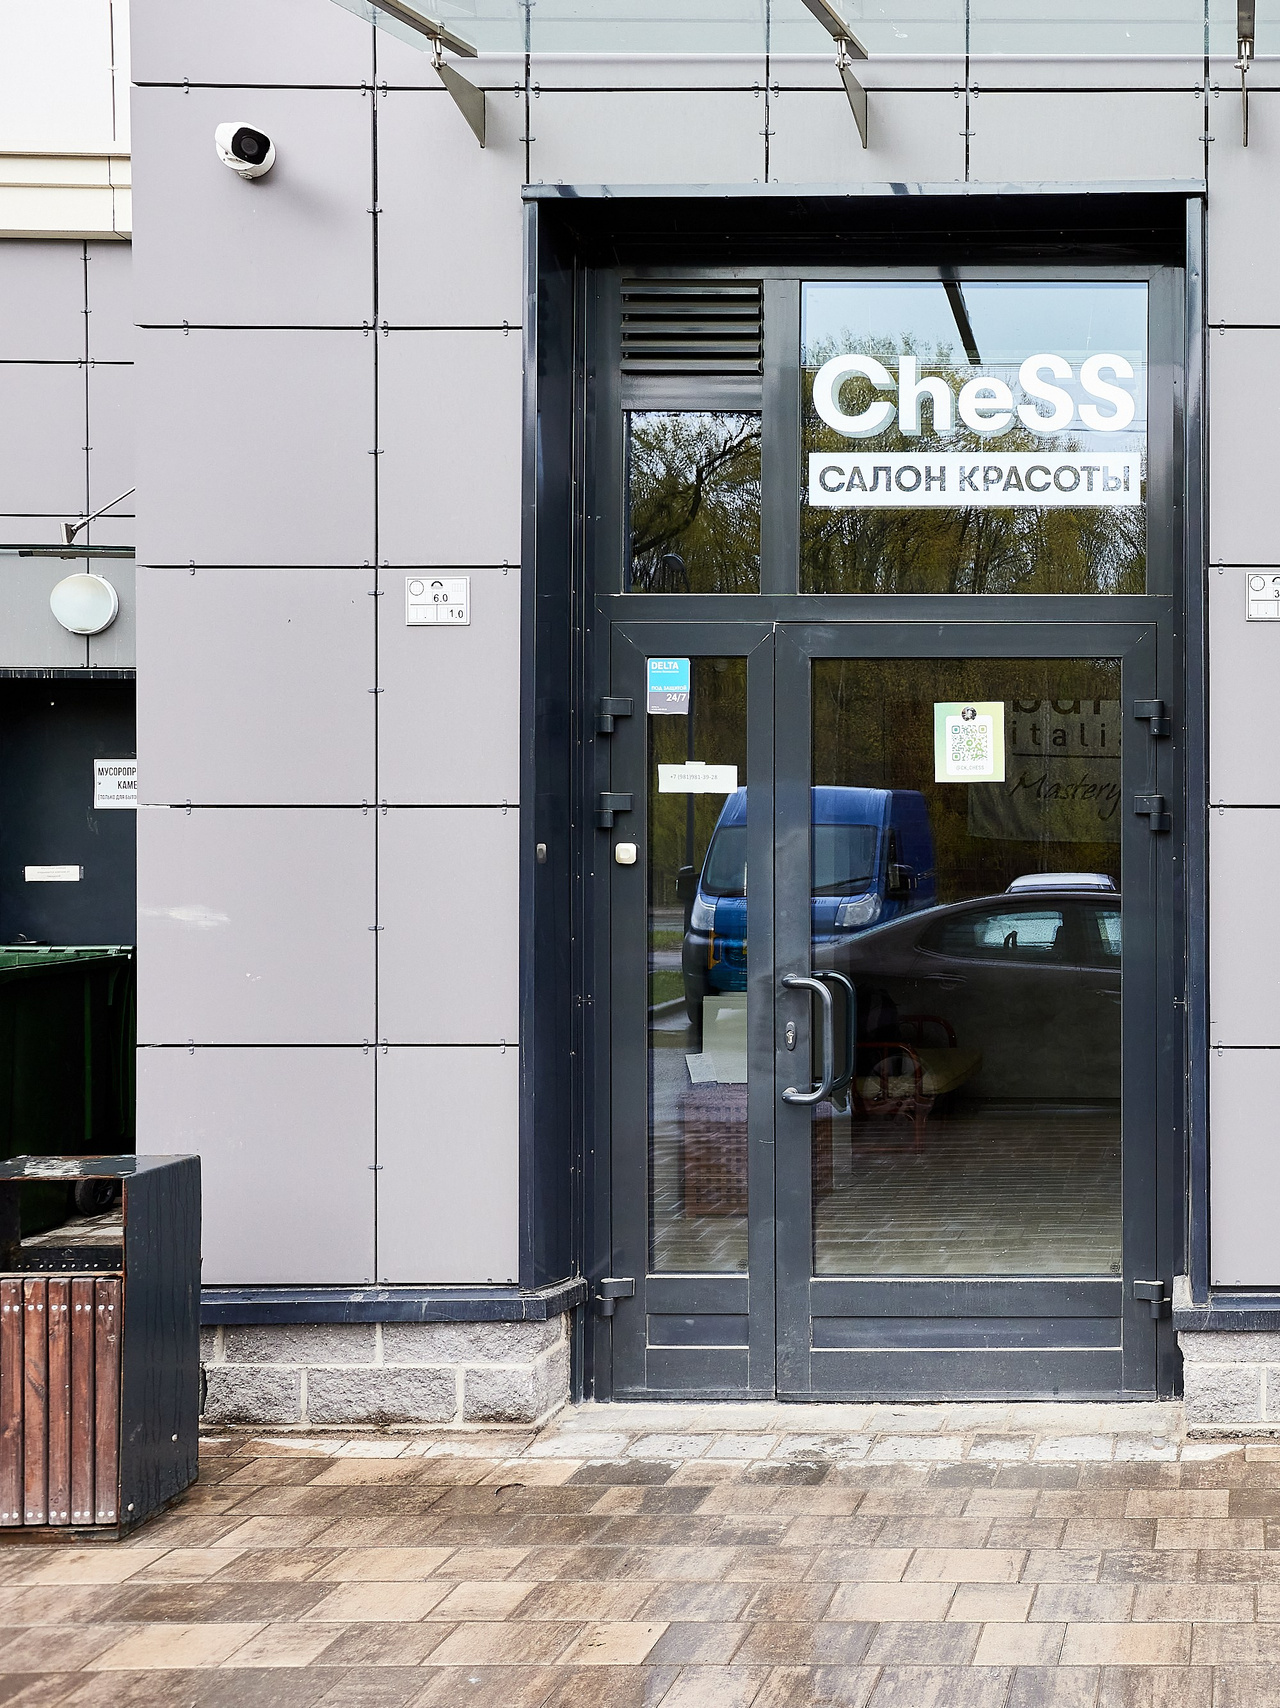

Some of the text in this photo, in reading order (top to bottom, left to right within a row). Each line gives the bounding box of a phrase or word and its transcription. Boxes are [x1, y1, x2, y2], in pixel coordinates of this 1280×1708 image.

[812, 353, 1136, 434] CheSS
[818, 465, 1130, 493] САЛОН КРАСОТЫ
[433, 593, 449, 603] 6.0
[449, 609, 464, 619] 1.0
[651, 661, 679, 670] DELTA
[666, 693, 687, 702] 24/7
[1012, 721, 1121, 748] itali
